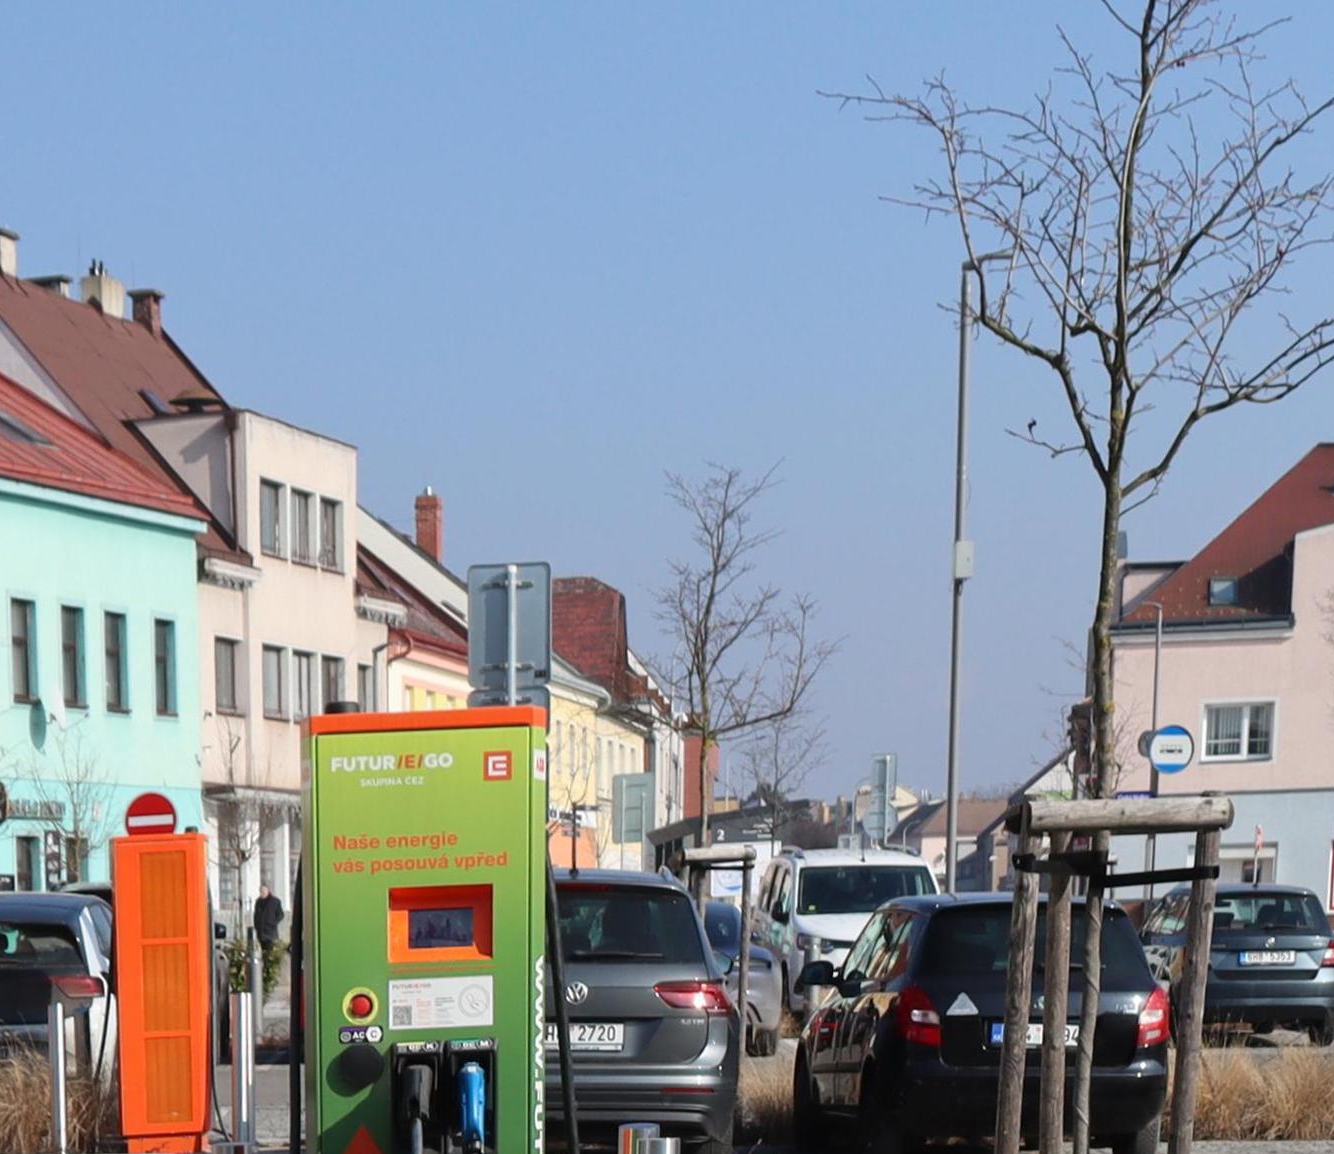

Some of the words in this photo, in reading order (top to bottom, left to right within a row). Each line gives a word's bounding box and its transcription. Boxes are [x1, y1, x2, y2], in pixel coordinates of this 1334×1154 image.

[333, 834, 380, 850] Naše
[386, 832, 458, 851] energie
[333, 858, 365, 874] vás
[370, 853, 449, 875] posouvá
[455, 852, 508, 870] vpřed
[578, 1025, 616, 1042] 2720
